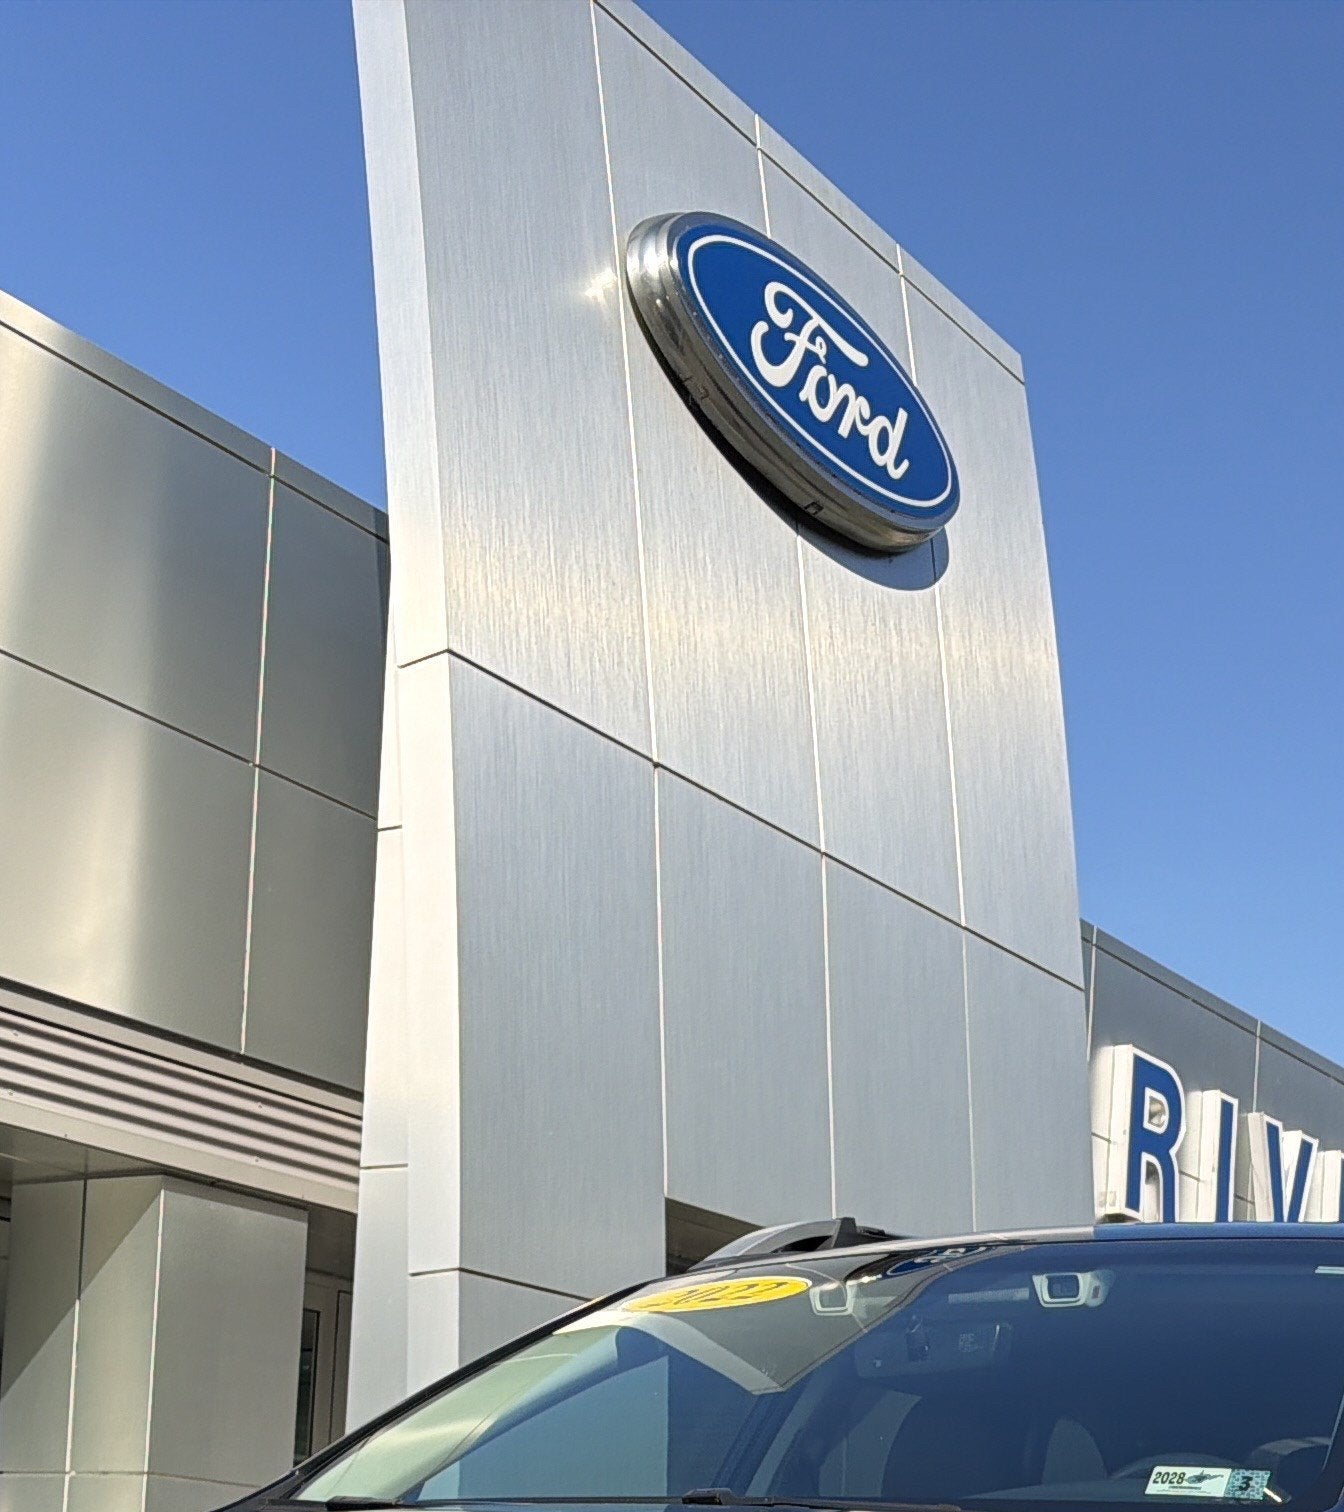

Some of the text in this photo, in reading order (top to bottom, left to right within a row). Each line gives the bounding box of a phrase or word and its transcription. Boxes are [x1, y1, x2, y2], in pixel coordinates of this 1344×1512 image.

[750, 281, 910, 480] Ford
[1153, 1472, 1186, 1484] 2028
[1238, 1475, 1253, 1491] 3
